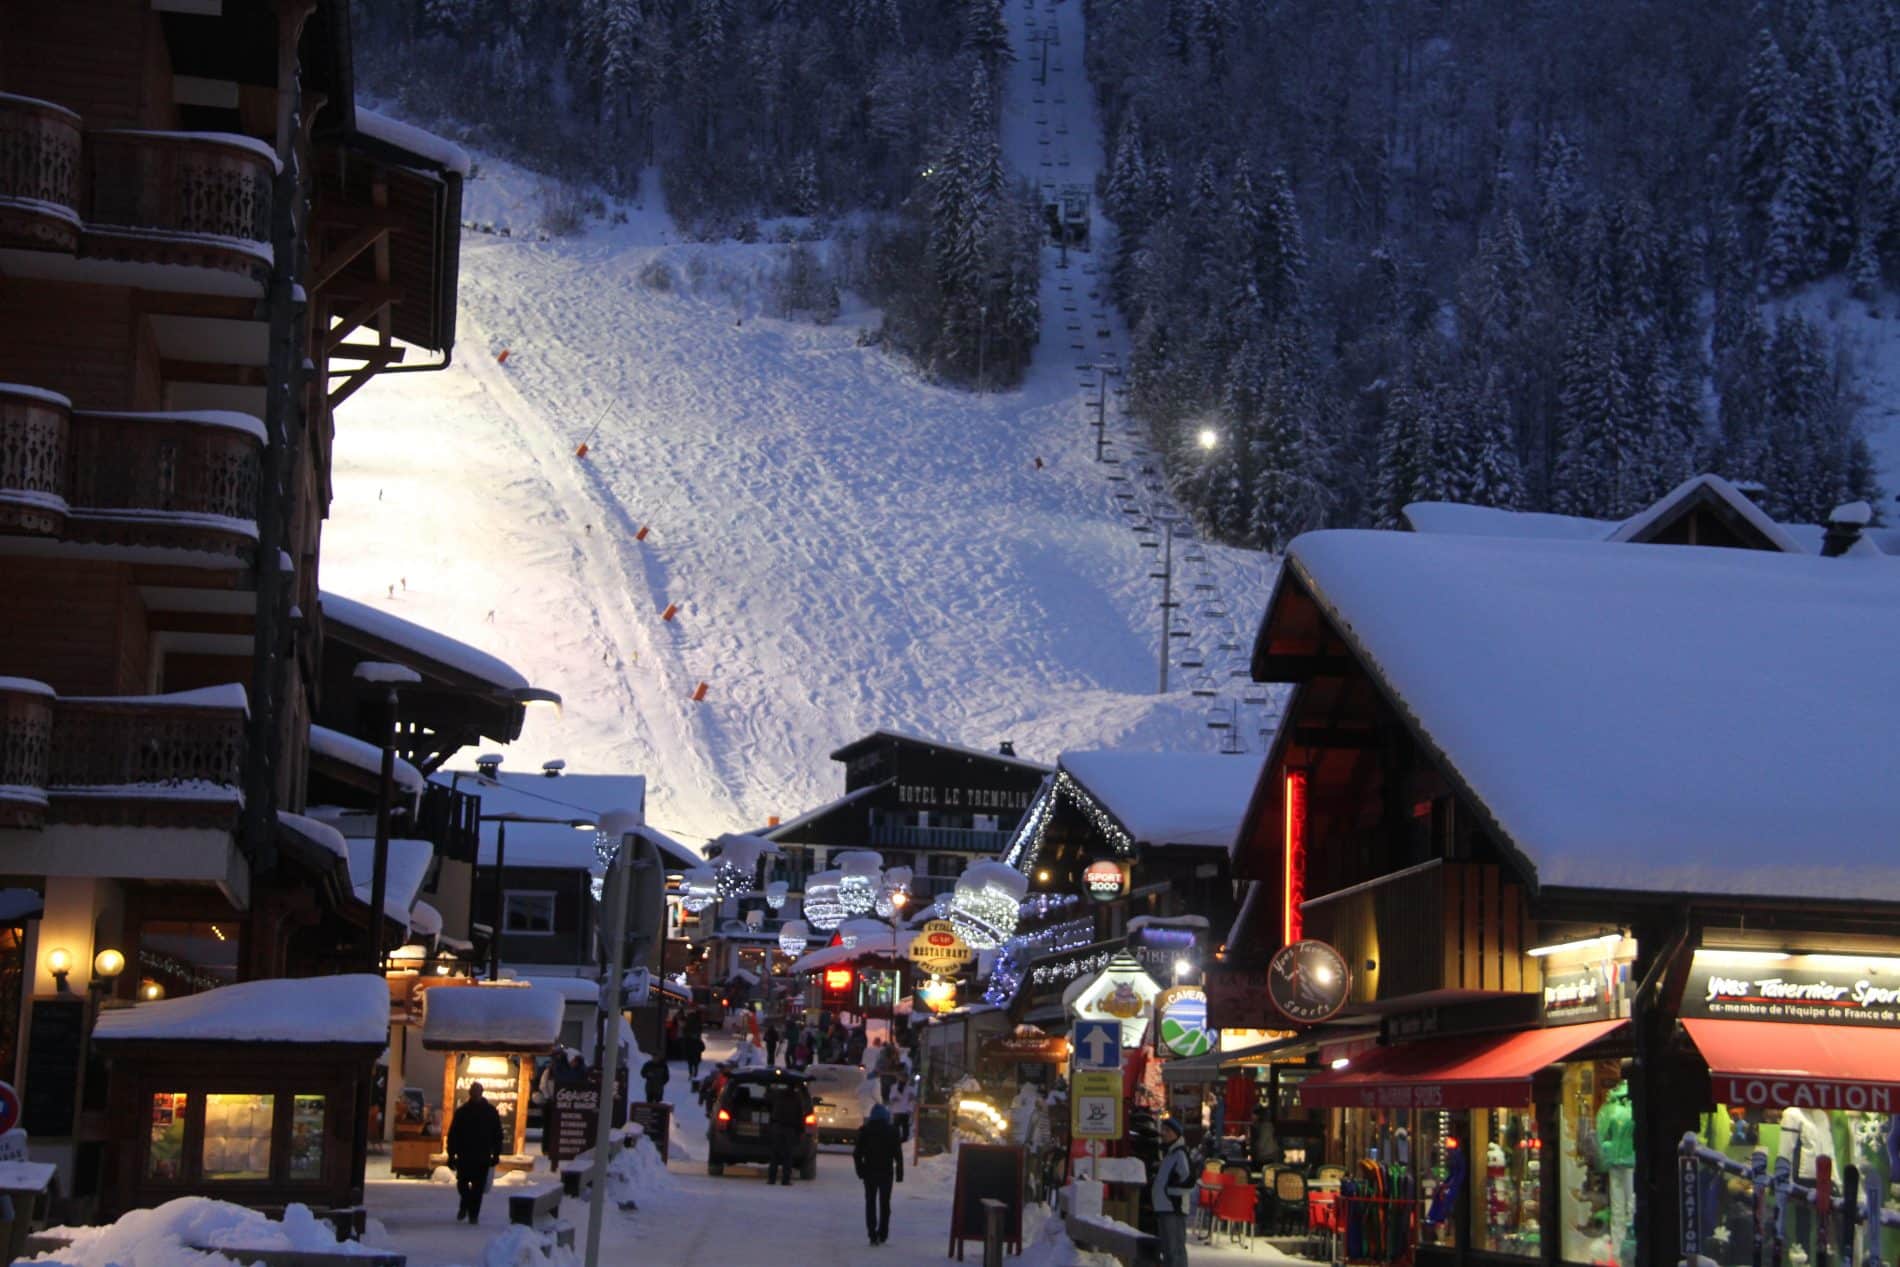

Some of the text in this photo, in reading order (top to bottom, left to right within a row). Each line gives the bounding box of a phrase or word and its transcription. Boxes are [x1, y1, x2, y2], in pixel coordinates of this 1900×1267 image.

[899, 785, 1028, 808] HOTEL LE TREMPLIN
[1087, 872, 1122, 882] SPORT
[1090, 881, 1119, 892] 2000
[913, 946, 968, 959] RESTAURANT
[1705, 975, 1750, 1002] Yves
[1754, 978, 1849, 1001] Tavernier
[1283, 1000, 1330, 1016] Sports
[1708, 1003, 1895, 1021] ex-membre de l'équipe de France de
[1729, 1079, 1892, 1111] LOCATION
[1684, 1161, 1697, 1253] LOCATION
